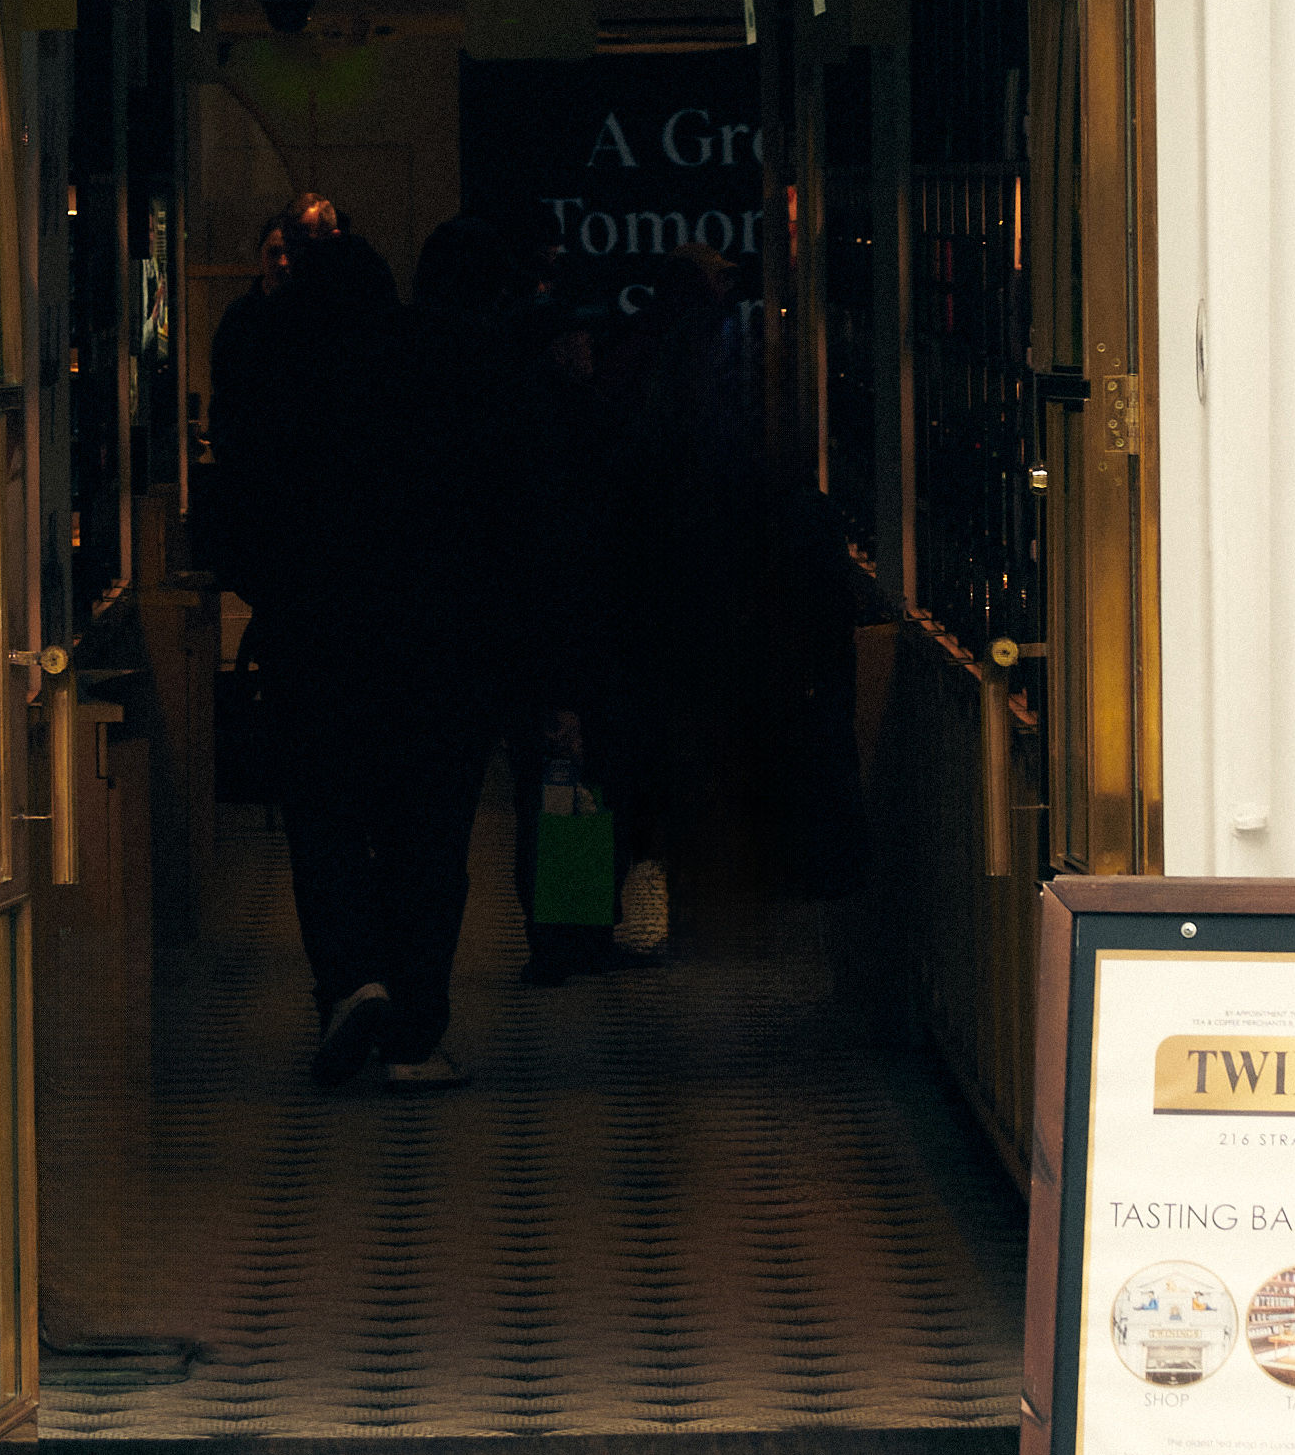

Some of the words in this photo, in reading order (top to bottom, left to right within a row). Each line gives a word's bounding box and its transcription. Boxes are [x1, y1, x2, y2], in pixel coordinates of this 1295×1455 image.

[586, 110, 639, 167] A
[1219, 1133, 1250, 1147] 216
[1110, 1201, 1238, 1231] TASTING
[1144, 1392, 1190, 1408] SHOP
